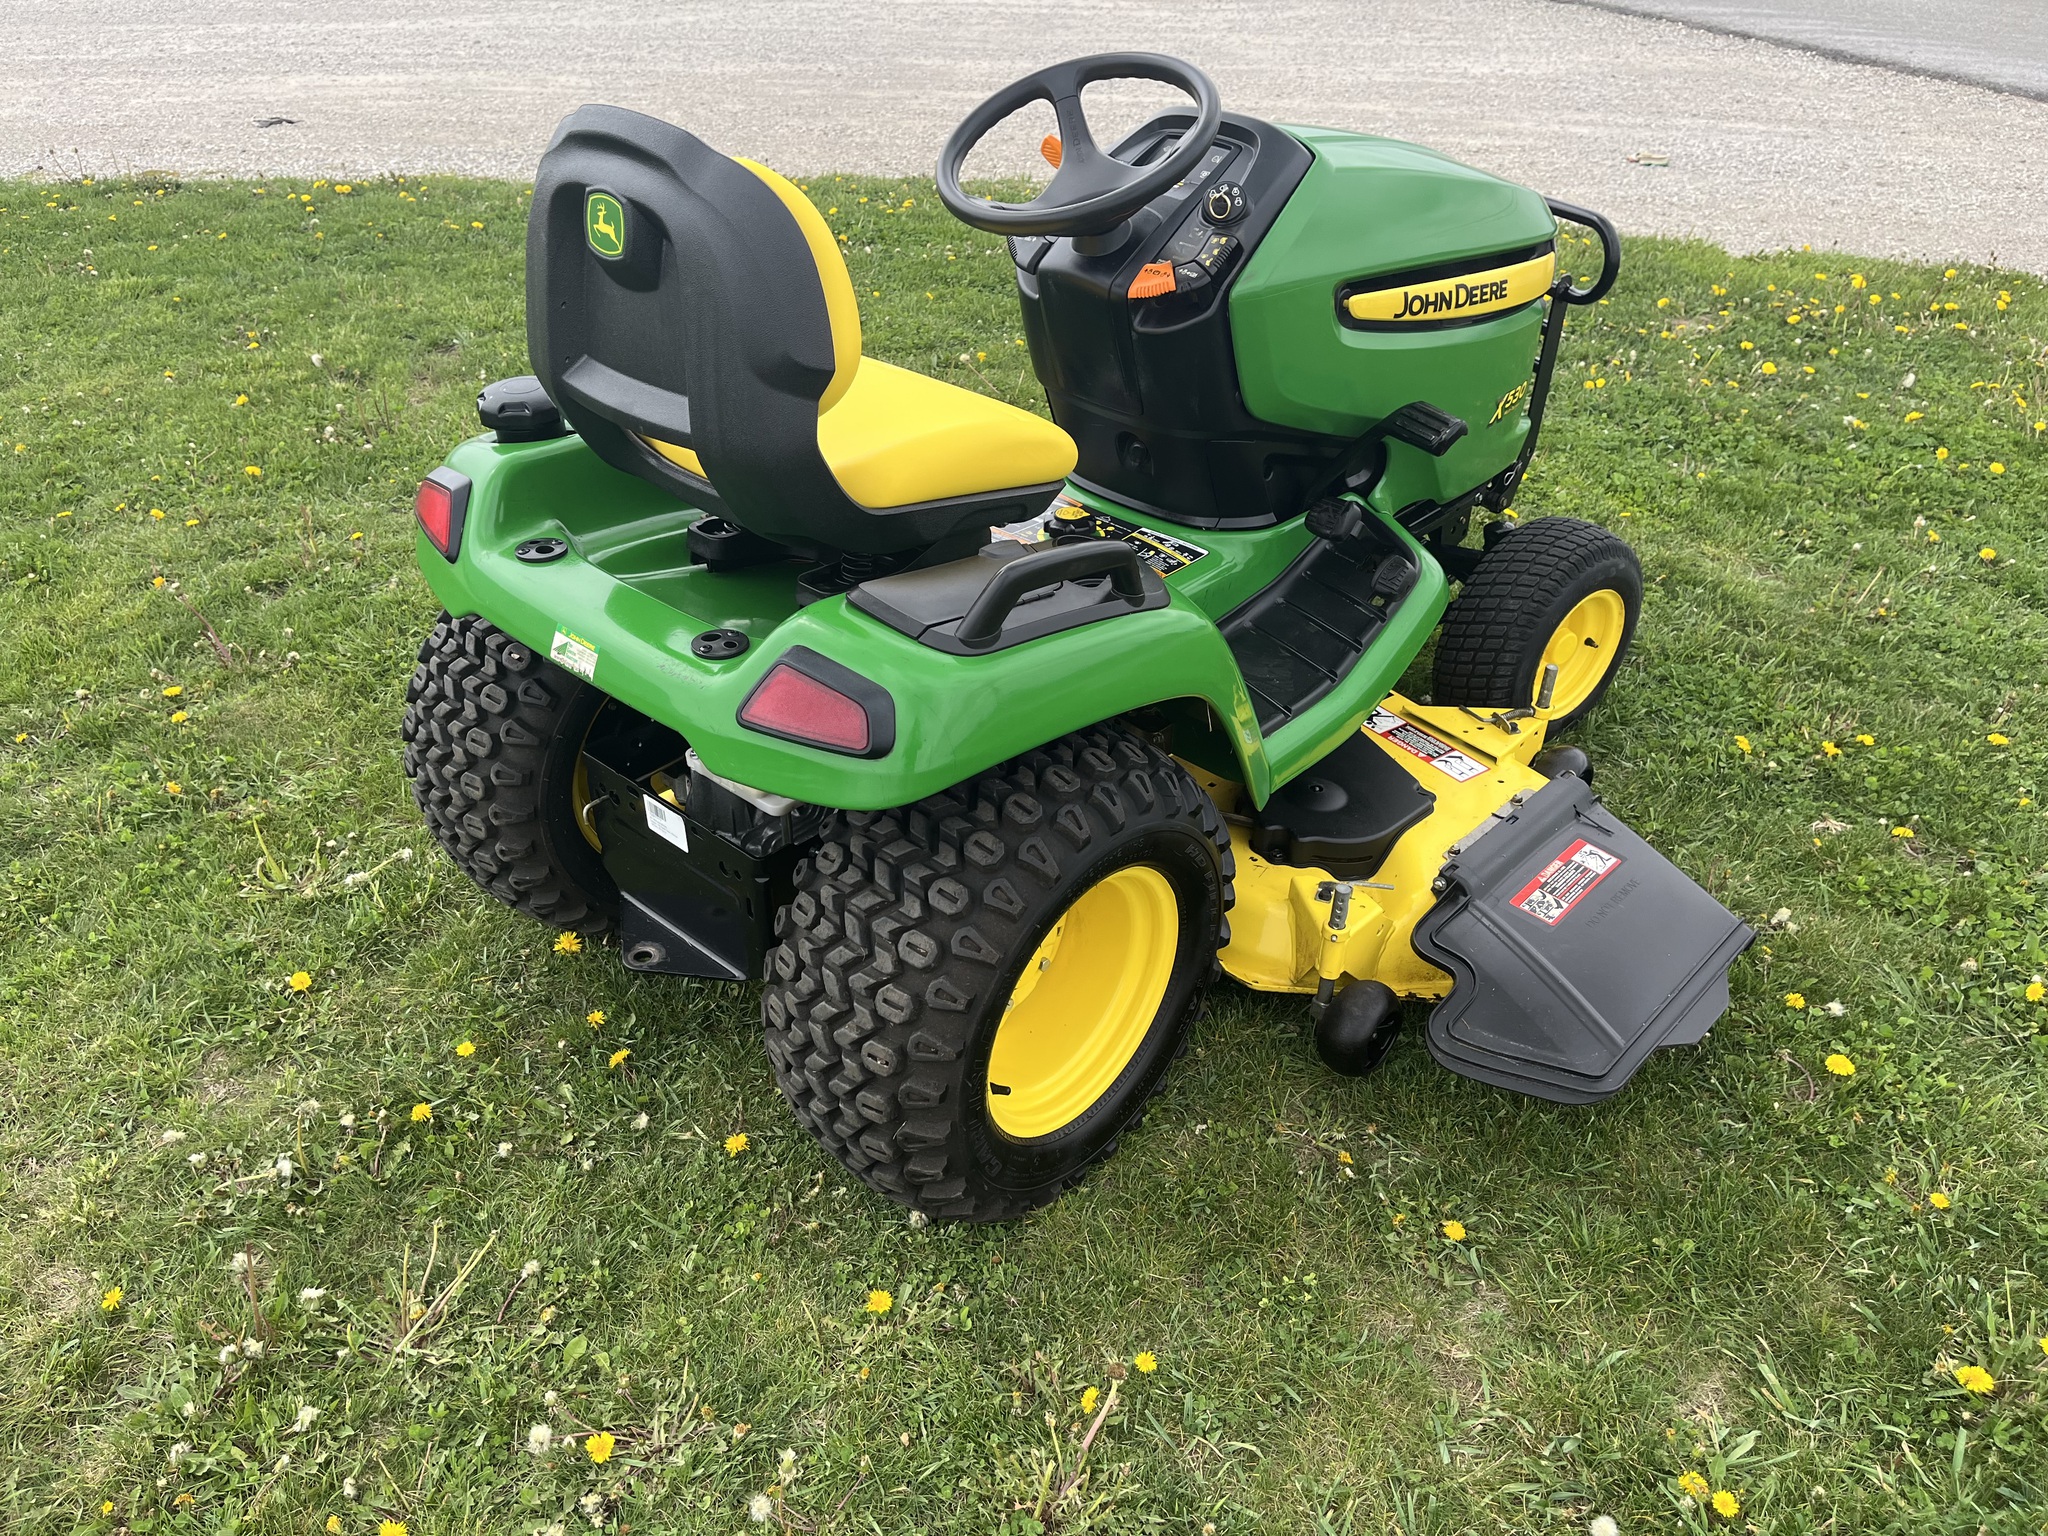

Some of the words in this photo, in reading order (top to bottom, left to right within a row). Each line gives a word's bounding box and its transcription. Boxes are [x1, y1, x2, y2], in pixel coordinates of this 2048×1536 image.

[1393, 291, 1453, 319] JOHN
[1454, 279, 1508, 309] DEERE
[1488, 380, 1528, 425] X530
[1388, 735, 1419, 755] DANGER
[1184, 842, 1207, 868] HD
[1544, 860, 1565, 878] DANGER
[1585, 915, 1601, 929] DO
[1596, 901, 1613, 919] NOT
[1610, 876, 1641, 904] REMOVE
